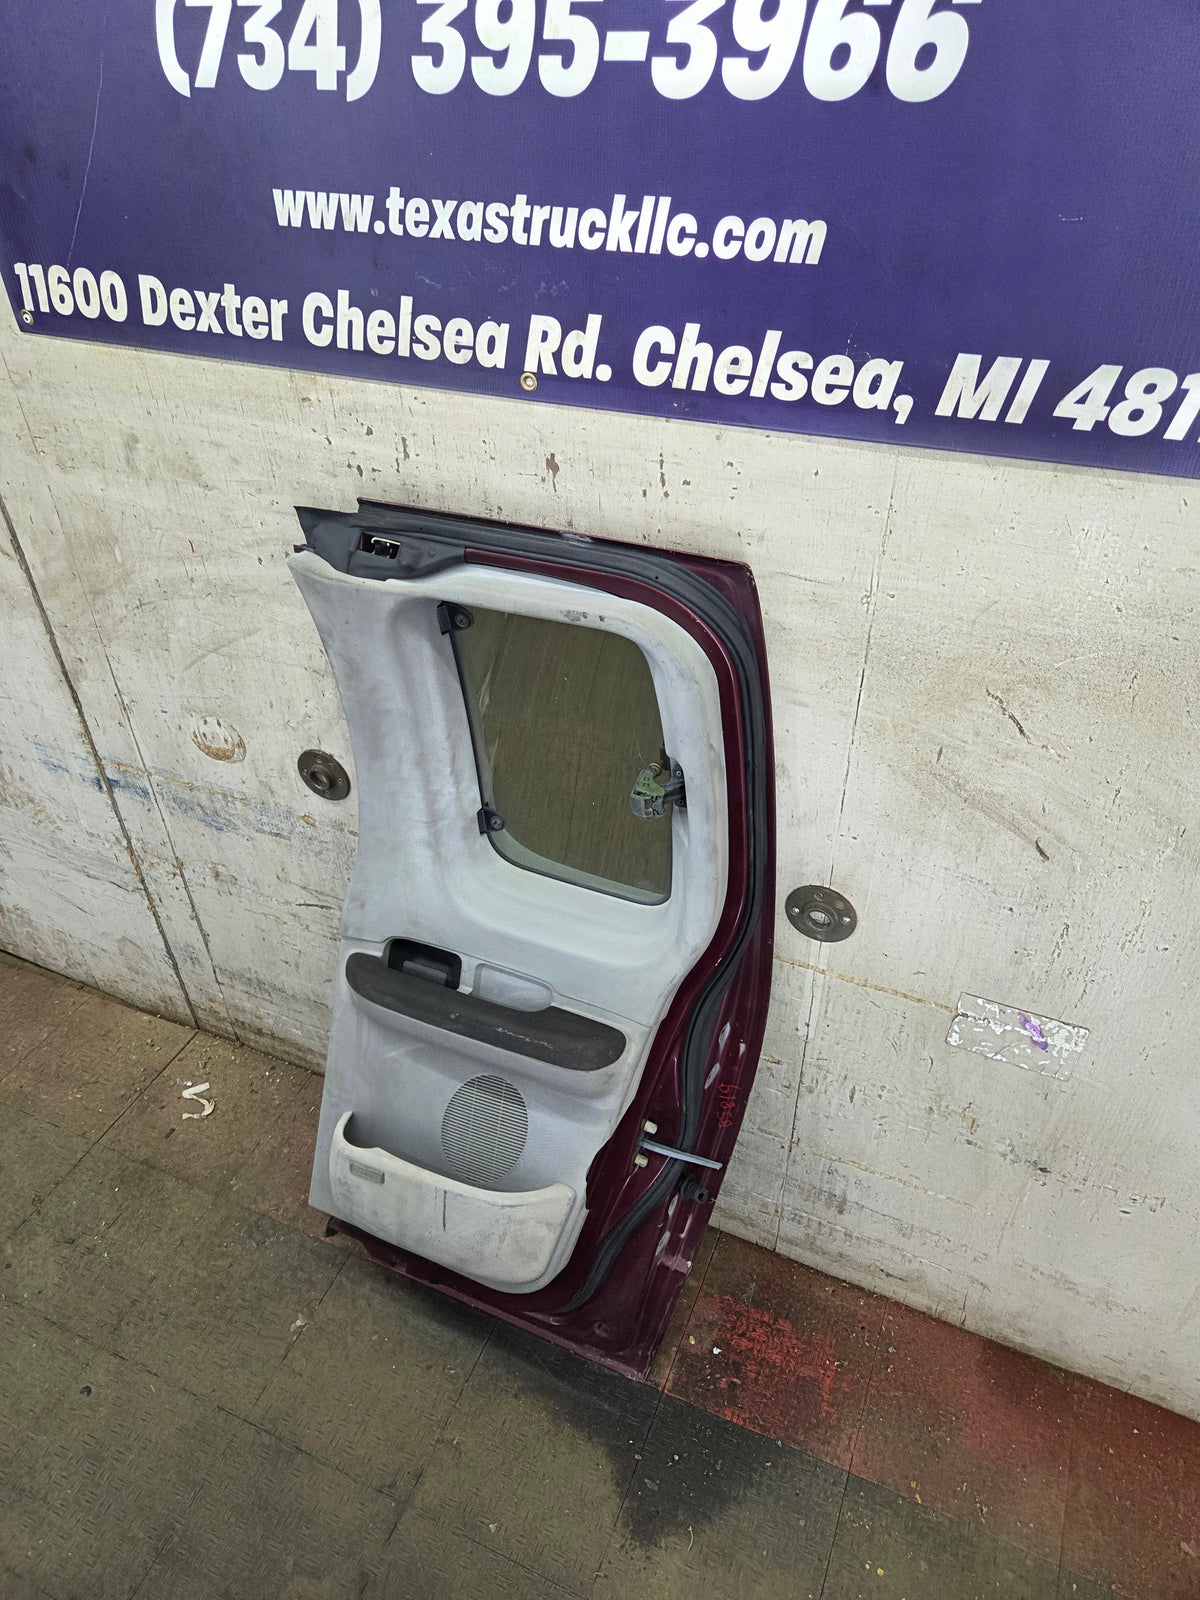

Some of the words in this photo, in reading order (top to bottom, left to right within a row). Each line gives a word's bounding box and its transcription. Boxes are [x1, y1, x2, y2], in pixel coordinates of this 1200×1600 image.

[155, 0, 382, 103] (734)
[411, 0, 982, 103] 395-3966
[273, 187, 828, 265] www.texastruckllc.com
[14, 263, 128, 323] 11600
[138, 274, 289, 342] Dexter
[302, 290, 510, 369] Chelsea
[523, 313, 613, 382] Rd.
[632, 322, 914, 425] Chelsea,
[934, 353, 1051, 425] MI
[1052, 364, 1200, 443] 481
